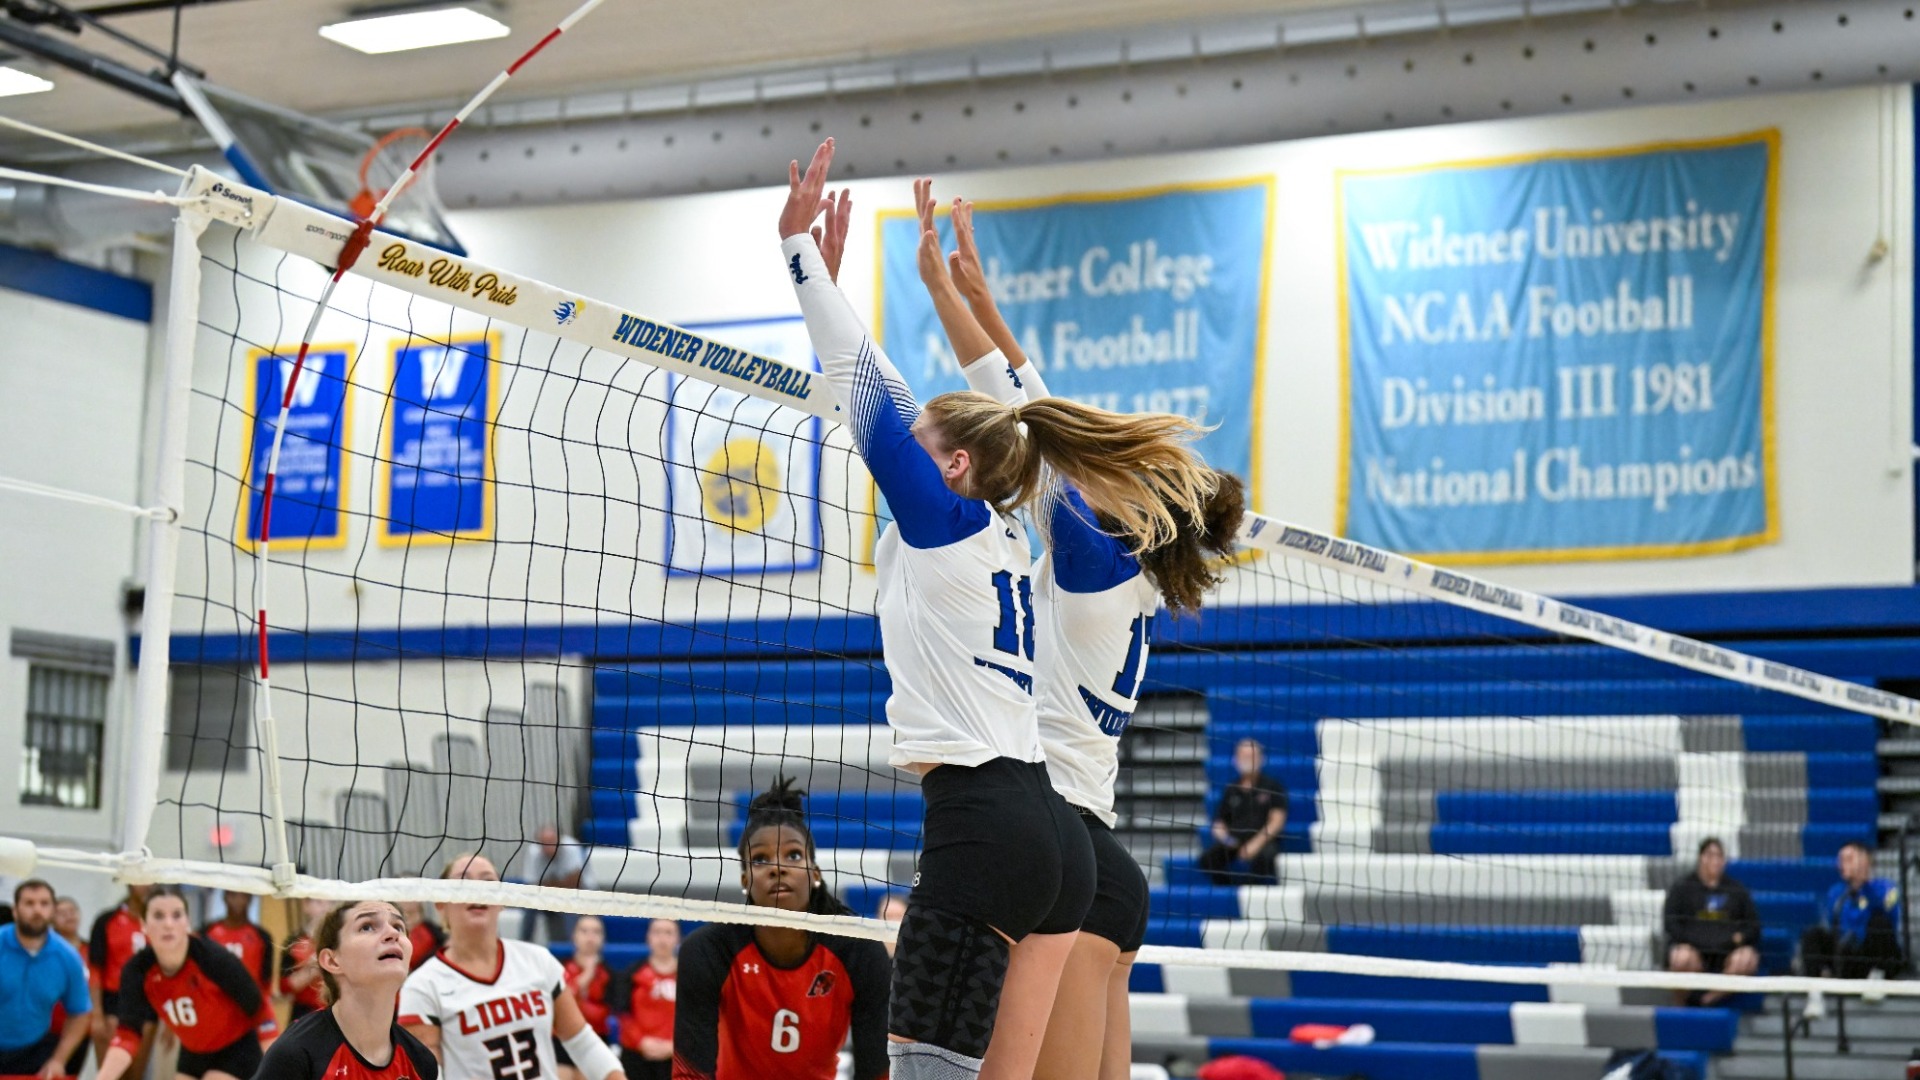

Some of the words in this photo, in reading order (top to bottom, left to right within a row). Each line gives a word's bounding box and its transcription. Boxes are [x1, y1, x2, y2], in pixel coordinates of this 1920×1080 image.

[1363, 216, 1528, 272] Widener
[1534, 201, 1740, 263] University
[378, 244, 423, 278] Roar
[429, 259, 471, 293] With
[473, 273, 517, 306] Pride
[986, 256, 1073, 304] dener
[1080, 238, 1214, 299] College
[1053, 309, 1199, 371] Football
[1381, 291, 1515, 345] NCAA
[1527, 274, 1694, 338] Football
[418, 345, 469, 400] W
[612, 314, 704, 367] WIDENER
[700, 341, 812, 400] VOLLEYBALL
[1382, 373, 1544, 429] Division
[1557, 364, 1616, 419] III
[1631, 362, 1715, 415] 1981
[1366, 449, 1527, 508] National
[1536, 445, 1757, 511] Champions
[162, 997, 198, 1027] 16
[457, 990, 546, 1036] LIONS
[770, 1008, 800, 1054] 6
[482, 1028, 541, 1080] 23
